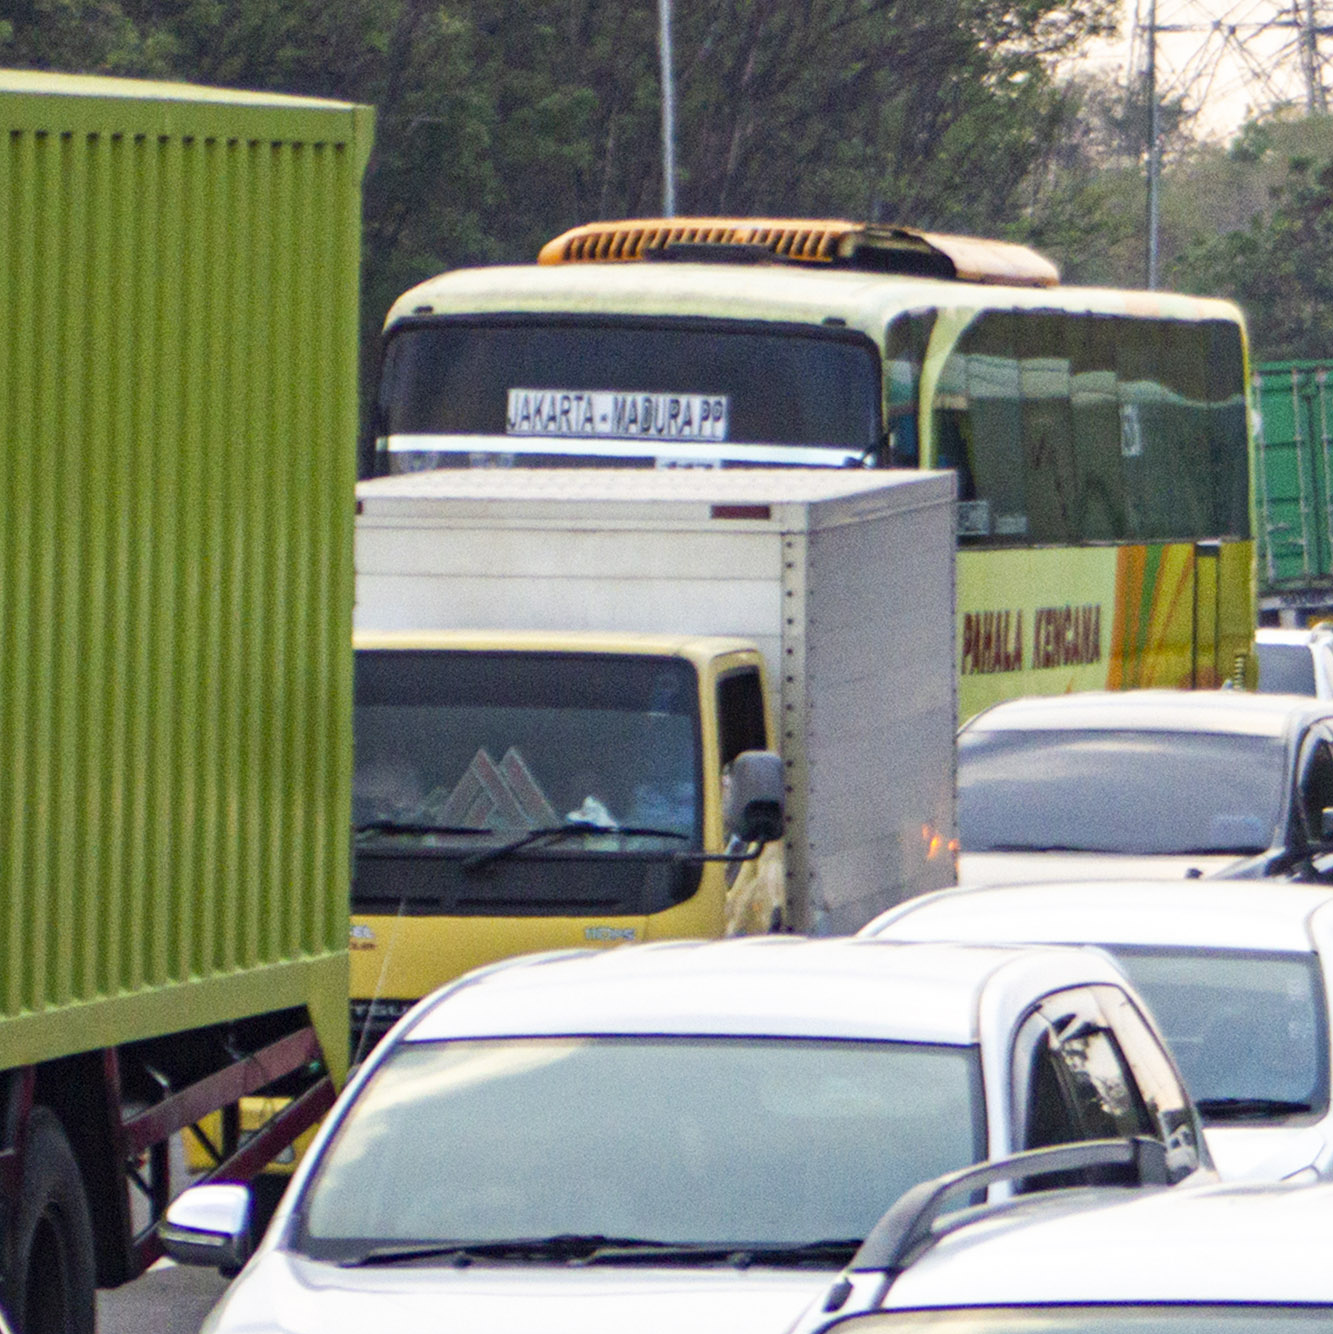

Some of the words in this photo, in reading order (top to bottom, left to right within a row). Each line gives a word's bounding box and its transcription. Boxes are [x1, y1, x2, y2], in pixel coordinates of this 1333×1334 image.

[507, 394, 595, 432] JAKARTA
[611, 396, 693, 436] MADURA
[700, 399, 724, 437] PP
[961, 608, 1023, 675] PAHALA
